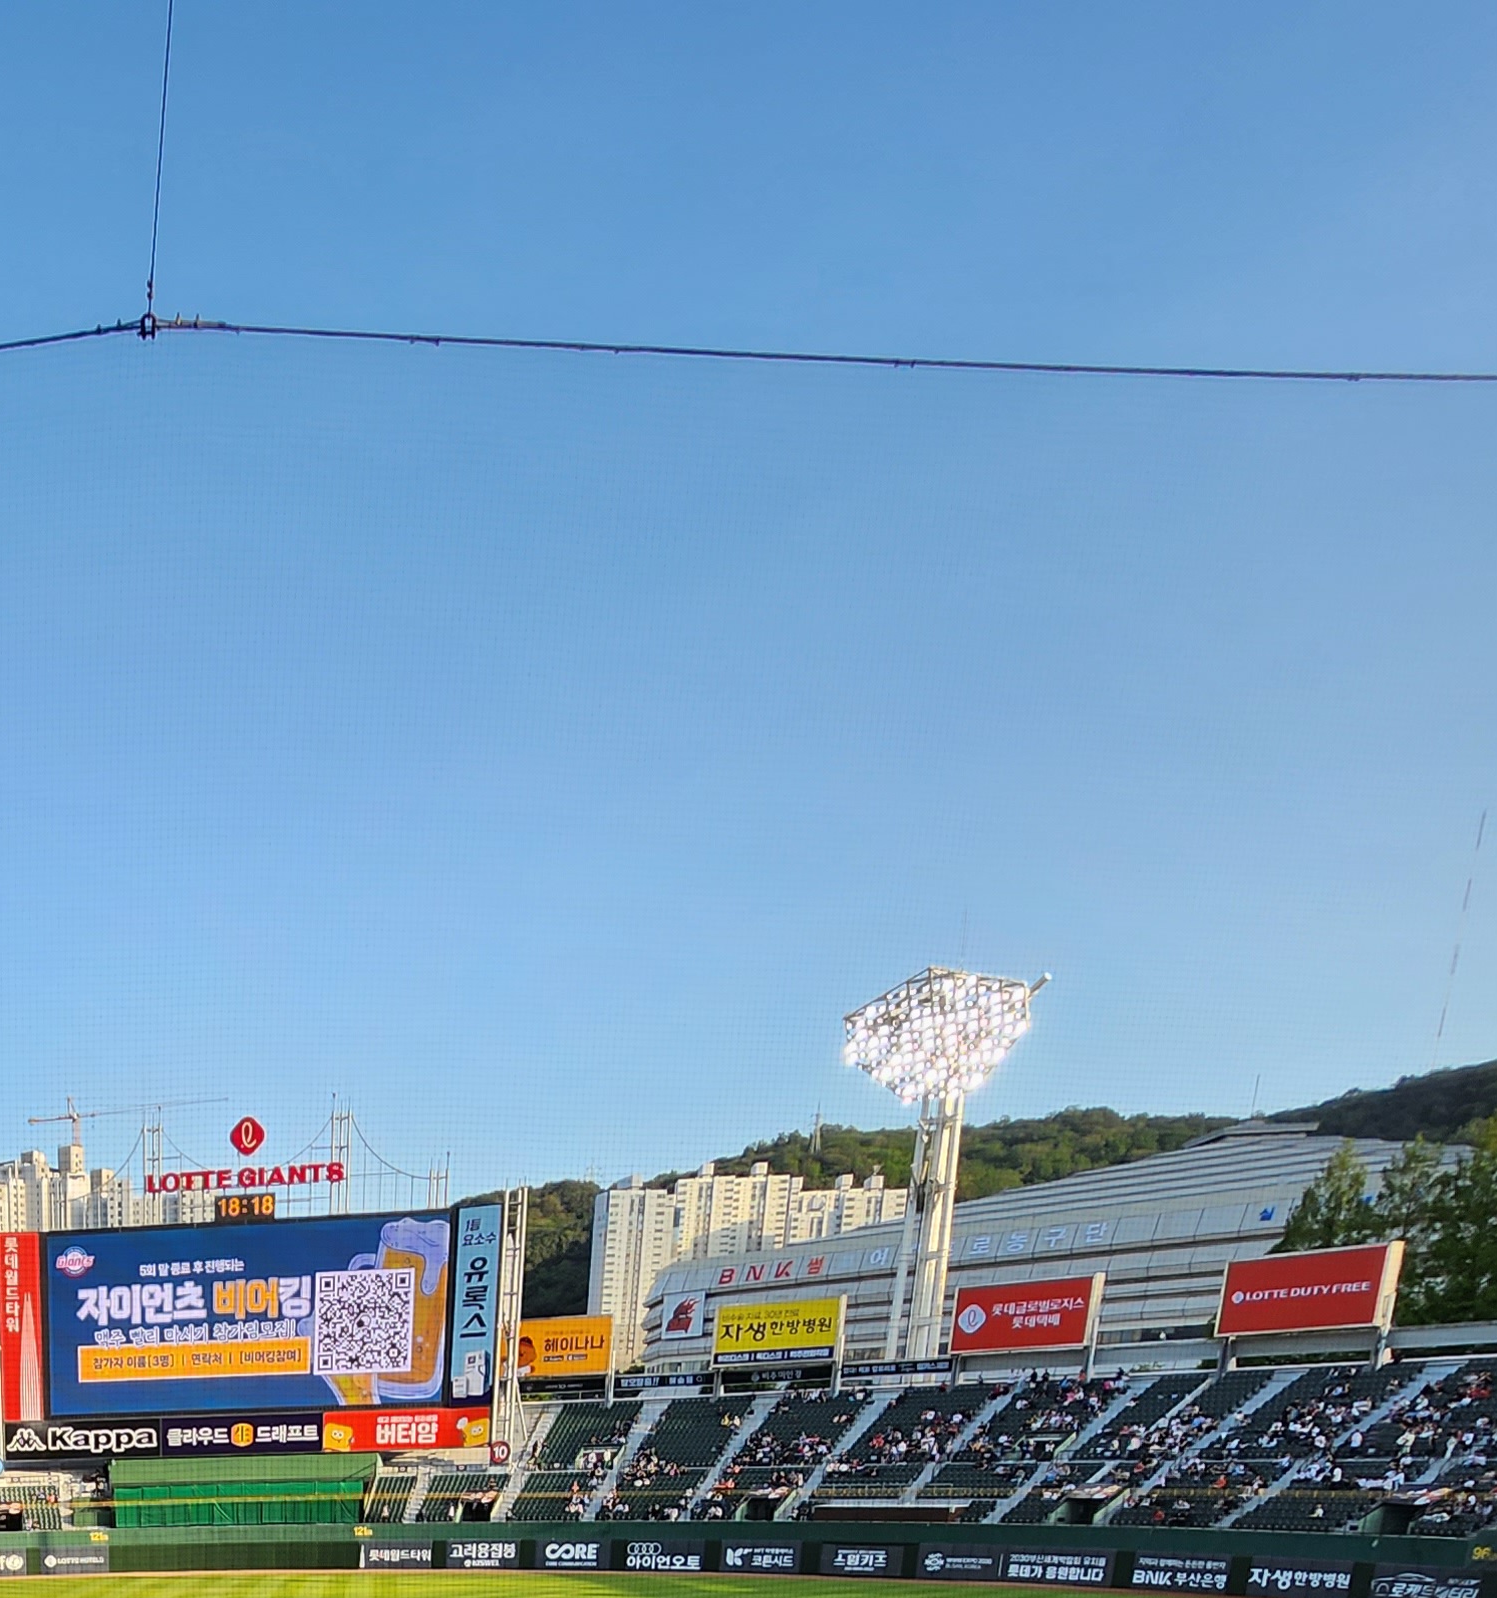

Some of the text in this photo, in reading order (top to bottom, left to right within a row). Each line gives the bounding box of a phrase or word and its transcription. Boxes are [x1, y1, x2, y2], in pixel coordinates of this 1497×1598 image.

[145, 1161, 345, 1194] LOTTE GIANTS
[217, 1195, 275, 1218] 18:18
[462, 1231, 497, 1247] 요소수
[718, 1260, 793, 1285] BNK
[3, 1236, 21, 1333] 롯데월드타워
[1245, 1280, 1371, 1302] LOTTE DUTY FREE
[75, 1275, 312, 1326] 자이언츠 비어킹
[459, 1257, 491, 1338] 유록스
[991, 1297, 1085, 1316] 롯데글로벌로지스
[720, 1316, 833, 1343] 자생한방병원
[1012, 1313, 1061, 1329] 롯데택배
[544, 1335, 605, 1352] 헤이나나
[48, 1426, 157, 1451] Kappa
[166, 1427, 229, 1447] 클라우드
[255, 1424, 320, 1443] 드래프트
[492, 1444, 508, 1460] 10
[369, 1549, 432, 1562] 롯데월드타워
[545, 1543, 598, 1560] CORE
[626, 1555, 701, 1570] 아이언오토
[1007, 1564, 1104, 1582] 롯데가 응원합니다
[1132, 1570, 1227, 1590] BNK 부산은행
[1248, 1568, 1350, 1590] 자생한방병원
